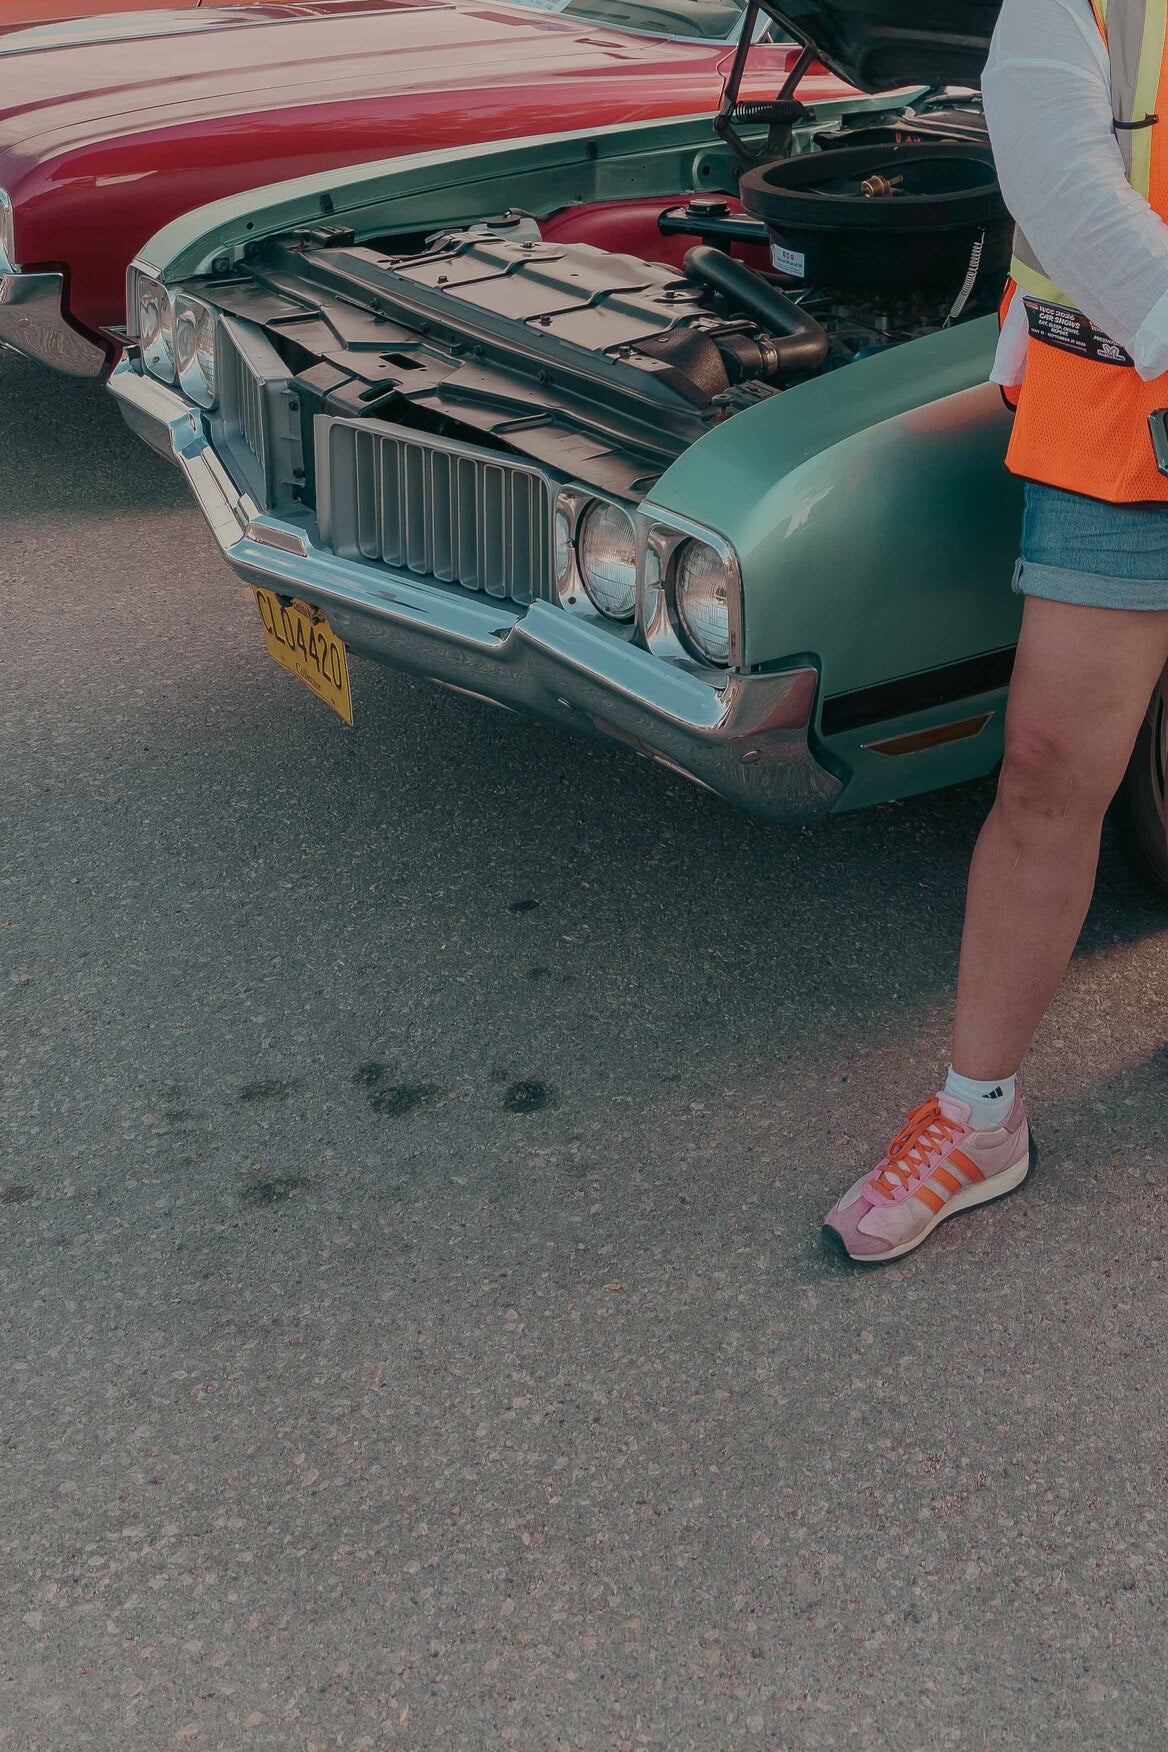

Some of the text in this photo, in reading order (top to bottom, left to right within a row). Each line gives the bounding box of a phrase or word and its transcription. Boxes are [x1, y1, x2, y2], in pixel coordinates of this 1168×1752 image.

[1039, 306, 1075, 321] WCC 2026
[1039, 313, 1054, 322] CAR
[1053, 316, 1081, 329] SHOWS
[256, 590, 343, 691] CL04420
